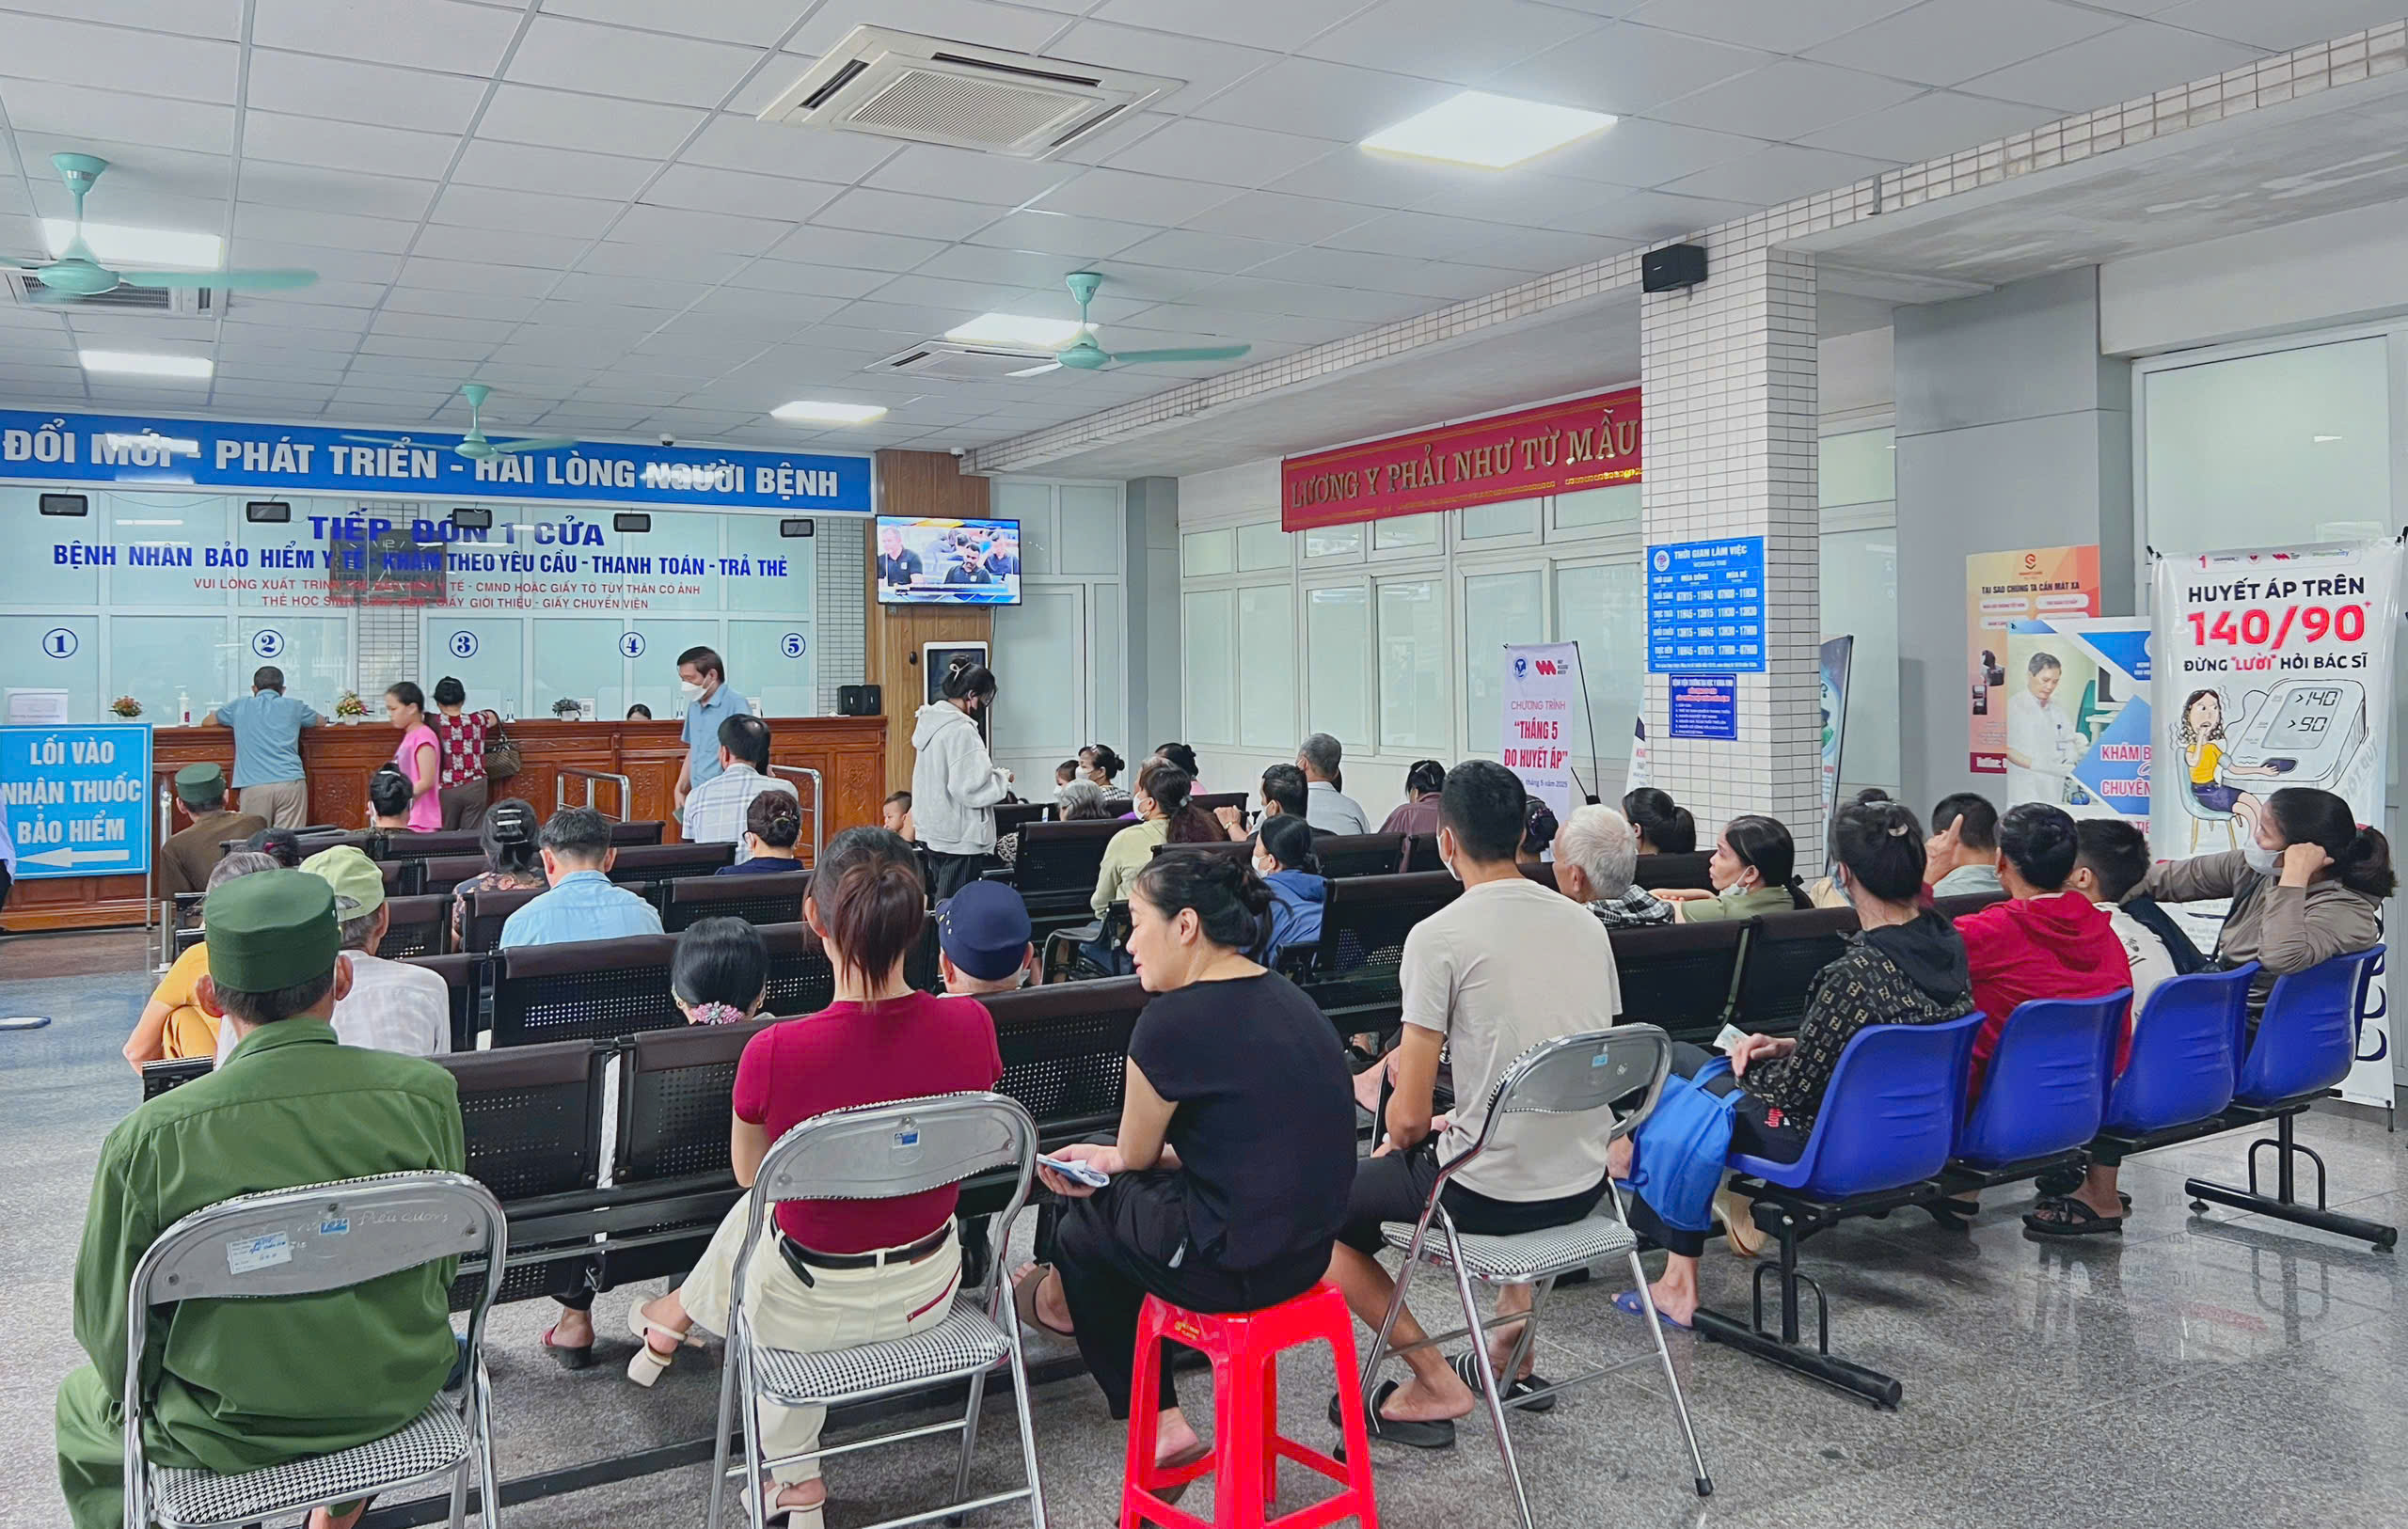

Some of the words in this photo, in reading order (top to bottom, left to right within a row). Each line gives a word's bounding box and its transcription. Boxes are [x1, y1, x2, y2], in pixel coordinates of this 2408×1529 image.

[3, 418, 75, 463] ĐỔI
[215, 436, 315, 474] PHÁT
[328, 436, 437, 479] TRIỂN
[547, 450, 635, 488] LÒNG
[646, 459, 745, 493] NGƯỜI
[755, 462, 838, 500] BỆNH
[1291, 472, 1361, 509] LƯƠNG
[1365, 466, 1381, 496] Y
[1386, 445, 1446, 494] PHẢI
[1452, 437, 1514, 482] NHƯ
[1521, 425, 1561, 470] TỪ
[1565, 408, 1640, 465] MẪU
[308, 508, 392, 543] TIẾP
[500, 522, 515, 544] 1
[534, 515, 605, 546] CỬA
[54, 541, 117, 570] BỆNH
[129, 543, 193, 567] NHÂN
[205, 541, 249, 568] BẢO
[261, 541, 315, 569] HIỂM
[322, 550, 333, 570] Y
[447, 552, 495, 572] THEO
[499, 551, 534, 573] YÊU
[540, 549, 578, 574] CẦU
[592, 555, 652, 575] THANH
[659, 554, 705, 575] TOÁN
[719, 553, 751, 576] TRẢ
[757, 555, 788, 576] THẺ
[194, 578, 215, 589] VUI
[220, 575, 257, 590] LÒNG
[261, 575, 295, 591] XUẤT
[450, 578, 465, 591] TẾ
[476, 582, 511, 592] CMND
[550, 580, 578, 593] GIẤY
[626, 581, 656, 594] THÂN
[659, 582, 674, 594] CÓ
[678, 582, 701, 594] ẢNH
[2188, 577, 2260, 603] HUYẾT
[2265, 577, 2297, 599] ÁP
[2303, 574, 2365, 597] TRÊN
[263, 593, 287, 607] THẺ
[498, 595, 531, 609] THIỆU
[543, 595, 570, 608] GIẤY
[574, 593, 619, 609] CHUYỂN
[623, 596, 648, 610] VIỆN
[53, 635, 67, 653] 1
[261, 635, 276, 653] 2
[457, 637, 470, 653] 3
[626, 637, 640, 653] 4
[788, 637, 800, 653] 5
[2184, 656, 2227, 671] ĐỪNG
[2280, 653, 2308, 670] HỎI
[2313, 653, 2347, 669] BÁC
[2352, 652, 2368, 669] SĨ
[1511, 700, 1544, 711] CHƯƠNG
[1545, 699, 1565, 711] TRÌNH
[1552, 720, 1558, 740] 5
[30, 733, 65, 765] LỐI
[71, 736, 116, 764] VÀO
[1520, 747, 1547, 768] HUYẾT
[2100, 742, 2139, 761] KHÁM
[0, 776, 64, 811] NHẬN
[71, 771, 142, 803] THUỐC
[17, 812, 63, 844] BẢO
[69, 810, 126, 843] HIỂM
